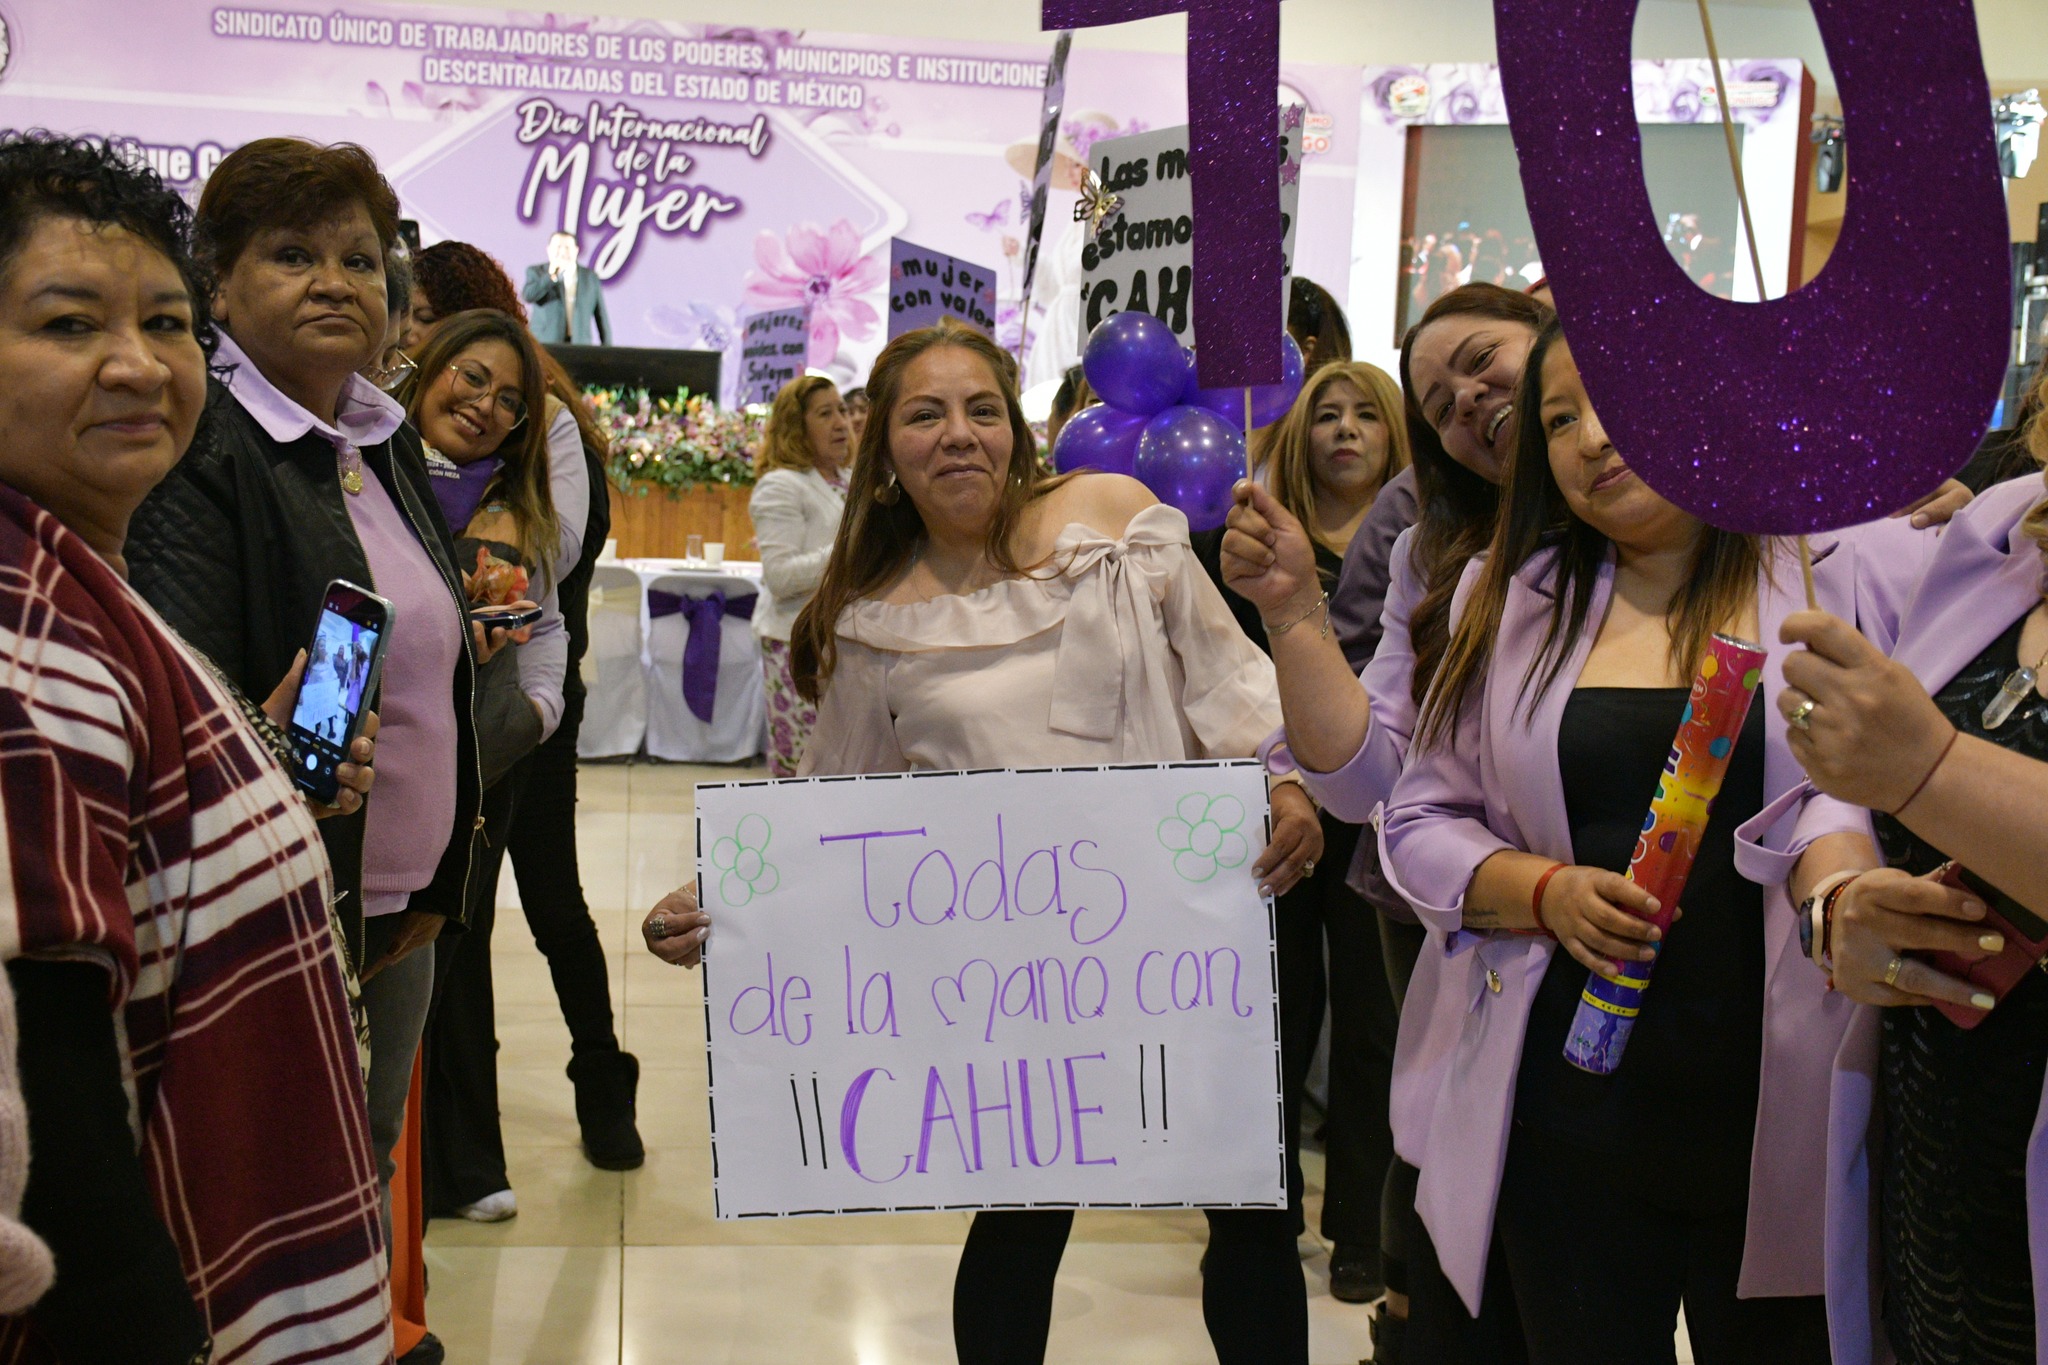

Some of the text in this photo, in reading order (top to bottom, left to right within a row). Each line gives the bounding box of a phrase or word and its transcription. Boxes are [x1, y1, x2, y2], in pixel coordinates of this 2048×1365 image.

[214, 9, 1049, 89] SINDICATO ÚNICO DE TRABAJADORES DE LOS PODERES, MUNICIPIOS E INSTITUCIONE
[425, 58, 863, 109] DESCENTRALIZADAS DEL ESTADO DE MÉXICO
[587, 101, 769, 156] Internacional
[614, 140, 693, 184] de la
[1100, 156, 1148, 192] Las
[522, 141, 737, 281] Mujer
[1081, 212, 1193, 272] estamo
[891, 289, 932, 313] con
[902, 258, 985, 293] mujer
[820, 813, 1127, 945] Todas
[729, 944, 1253, 1046] de la mano con
